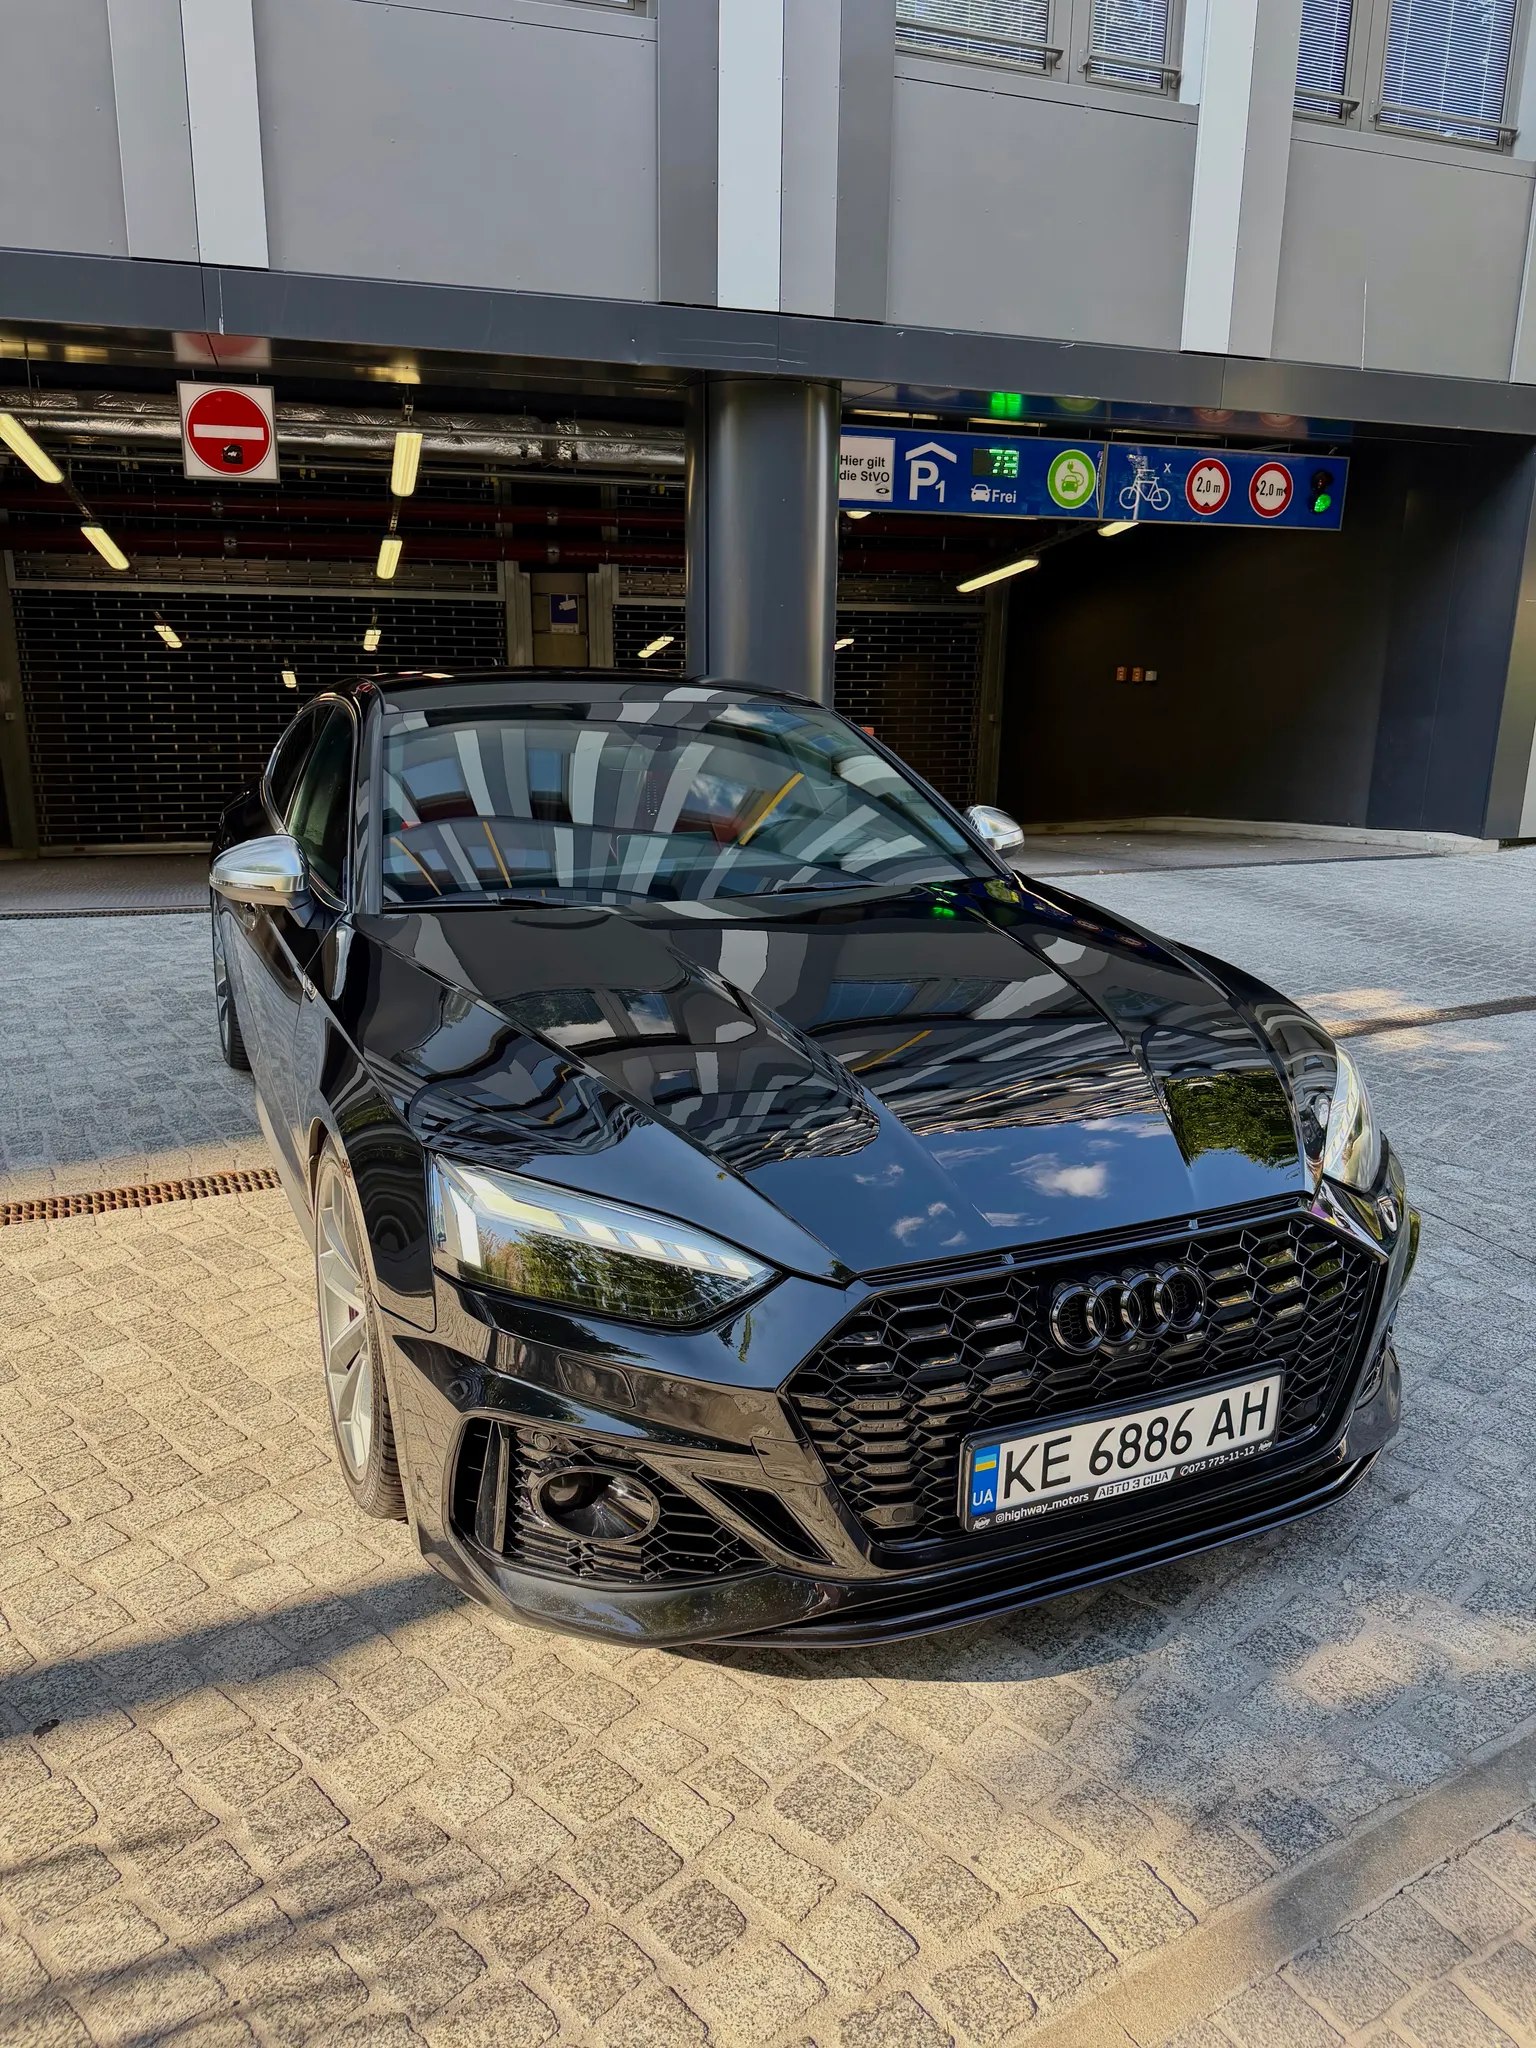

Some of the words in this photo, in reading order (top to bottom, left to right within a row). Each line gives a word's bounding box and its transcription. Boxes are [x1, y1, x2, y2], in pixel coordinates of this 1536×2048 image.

[840, 455, 864, 467] Hier
[867, 456, 885, 469] gilt
[839, 470, 857, 481] die
[860, 471, 890, 482] StVO
[1196, 476, 1212, 494] 2,0
[1213, 484, 1221, 494] m
[1259, 480, 1274, 497] 2,0
[1276, 487, 1284, 497] m
[991, 489, 1017, 503] Frei
[1003, 1435, 1072, 1500] KE
[1088, 1407, 1195, 1476] 6886
[1206, 1386, 1271, 1446] AH
[1208, 1445, 1255, 1468] 773-11-12
[972, 1488, 994, 1506] UA
